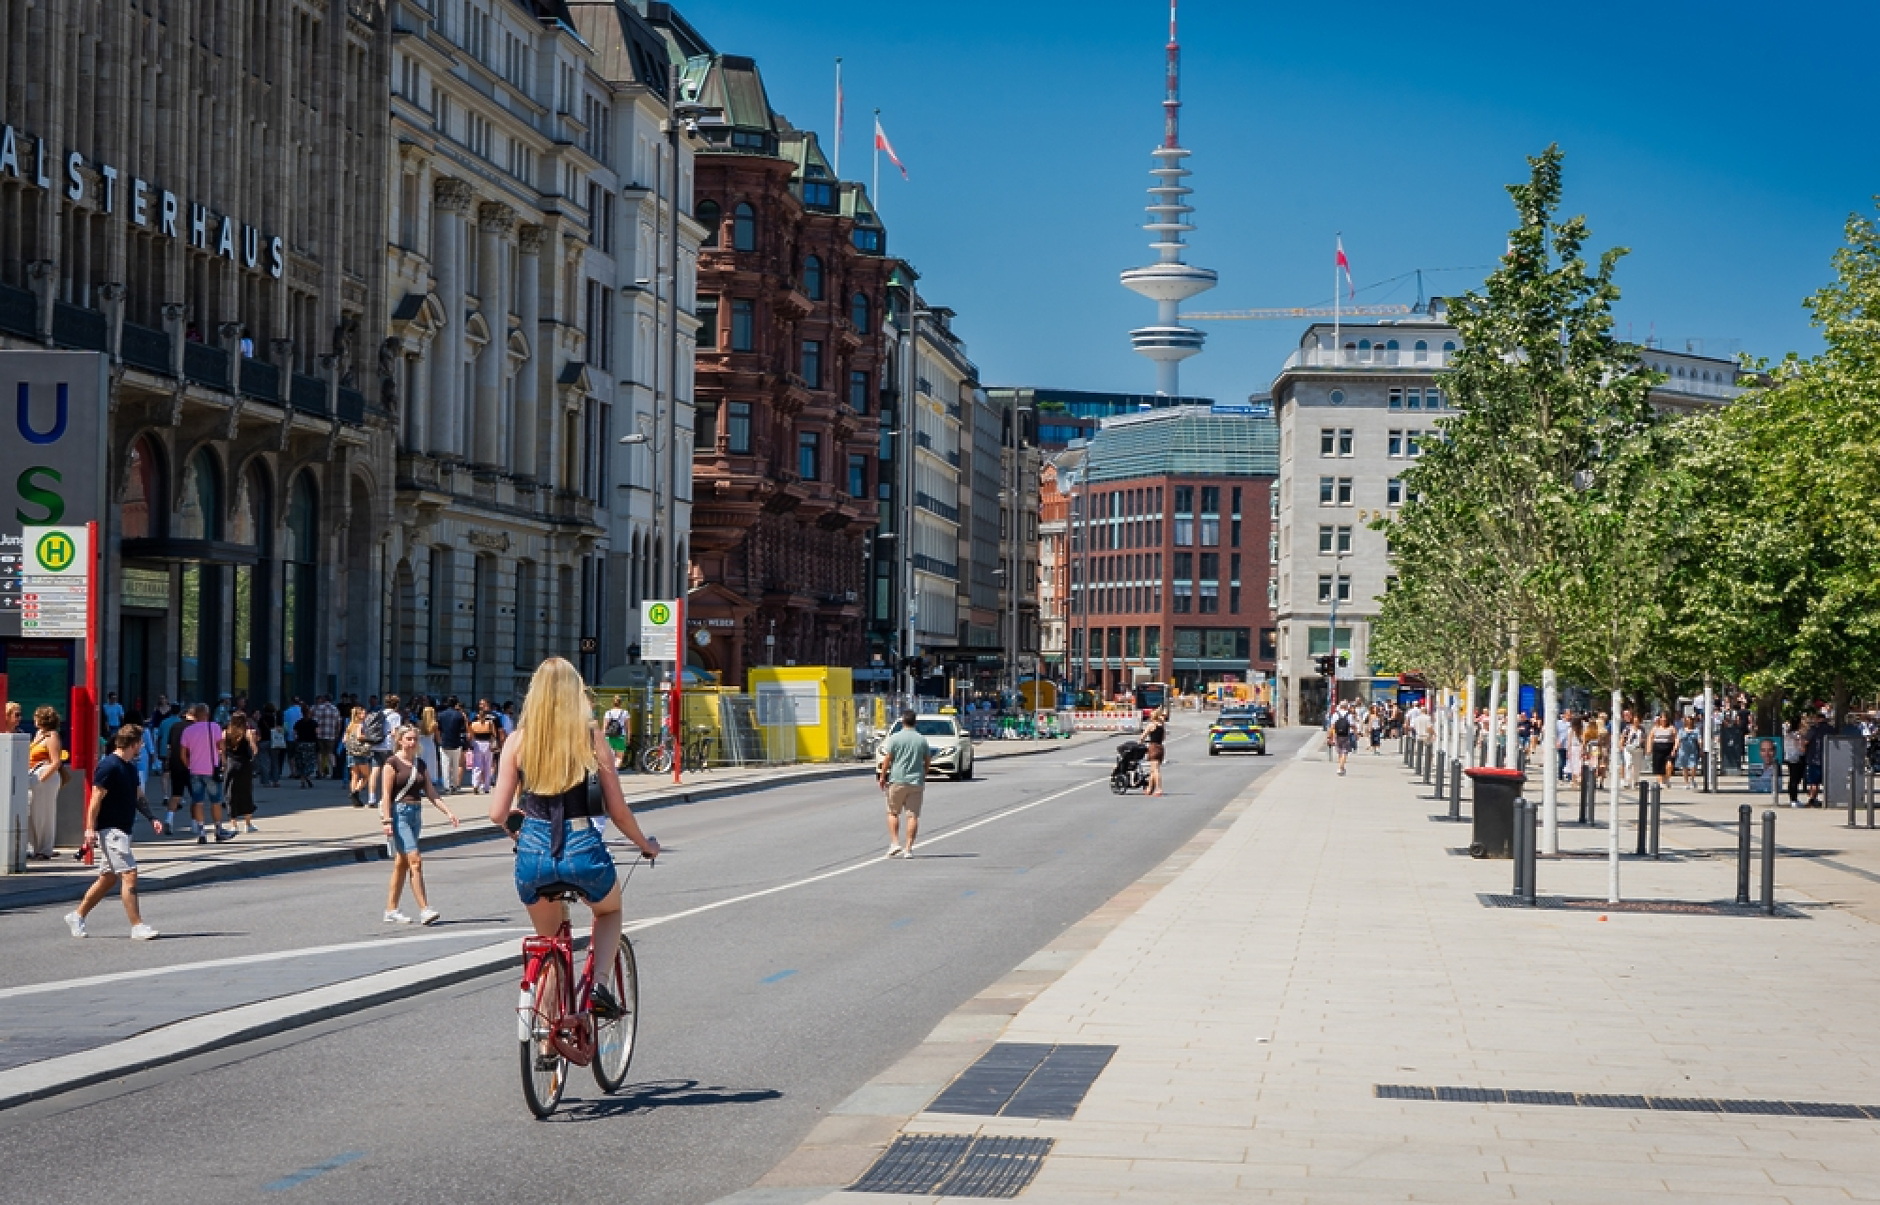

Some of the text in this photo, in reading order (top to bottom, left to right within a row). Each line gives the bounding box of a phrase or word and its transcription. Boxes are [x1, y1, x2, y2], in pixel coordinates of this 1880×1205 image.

[0, 125, 283, 279] ALSTERHAUS
[17, 382, 68, 444] U
[16, 466, 65, 526] S
[46, 541, 65, 562] H
